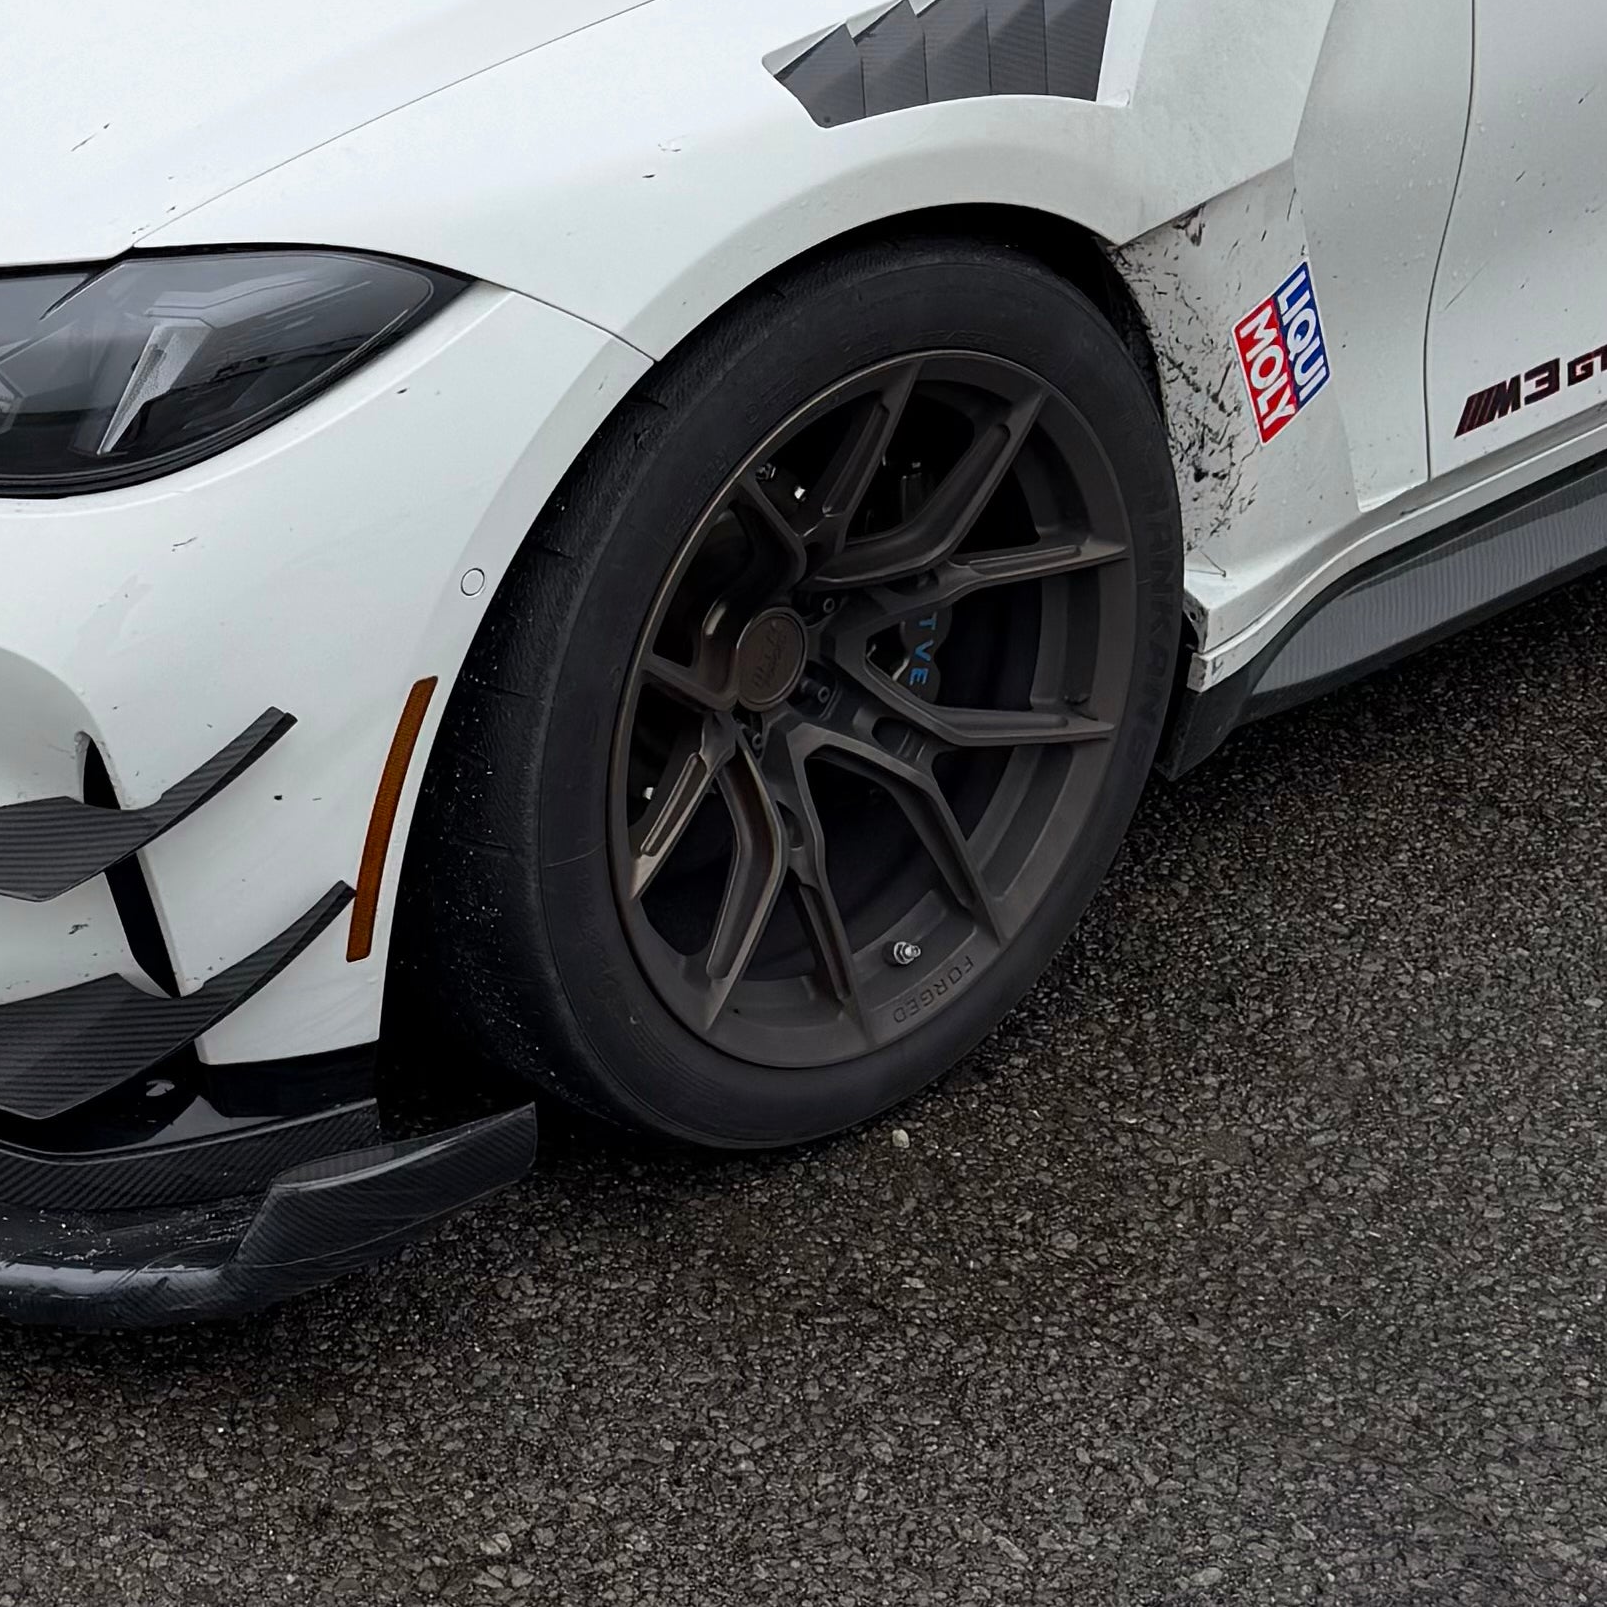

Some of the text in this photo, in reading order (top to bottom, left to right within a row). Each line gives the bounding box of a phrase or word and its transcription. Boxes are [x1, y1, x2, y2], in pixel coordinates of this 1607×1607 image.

[1240, 306, 1295, 430] MOLY
[1277, 270, 1327, 401] LIQUI
[894, 956, 973, 1023] FORGED
